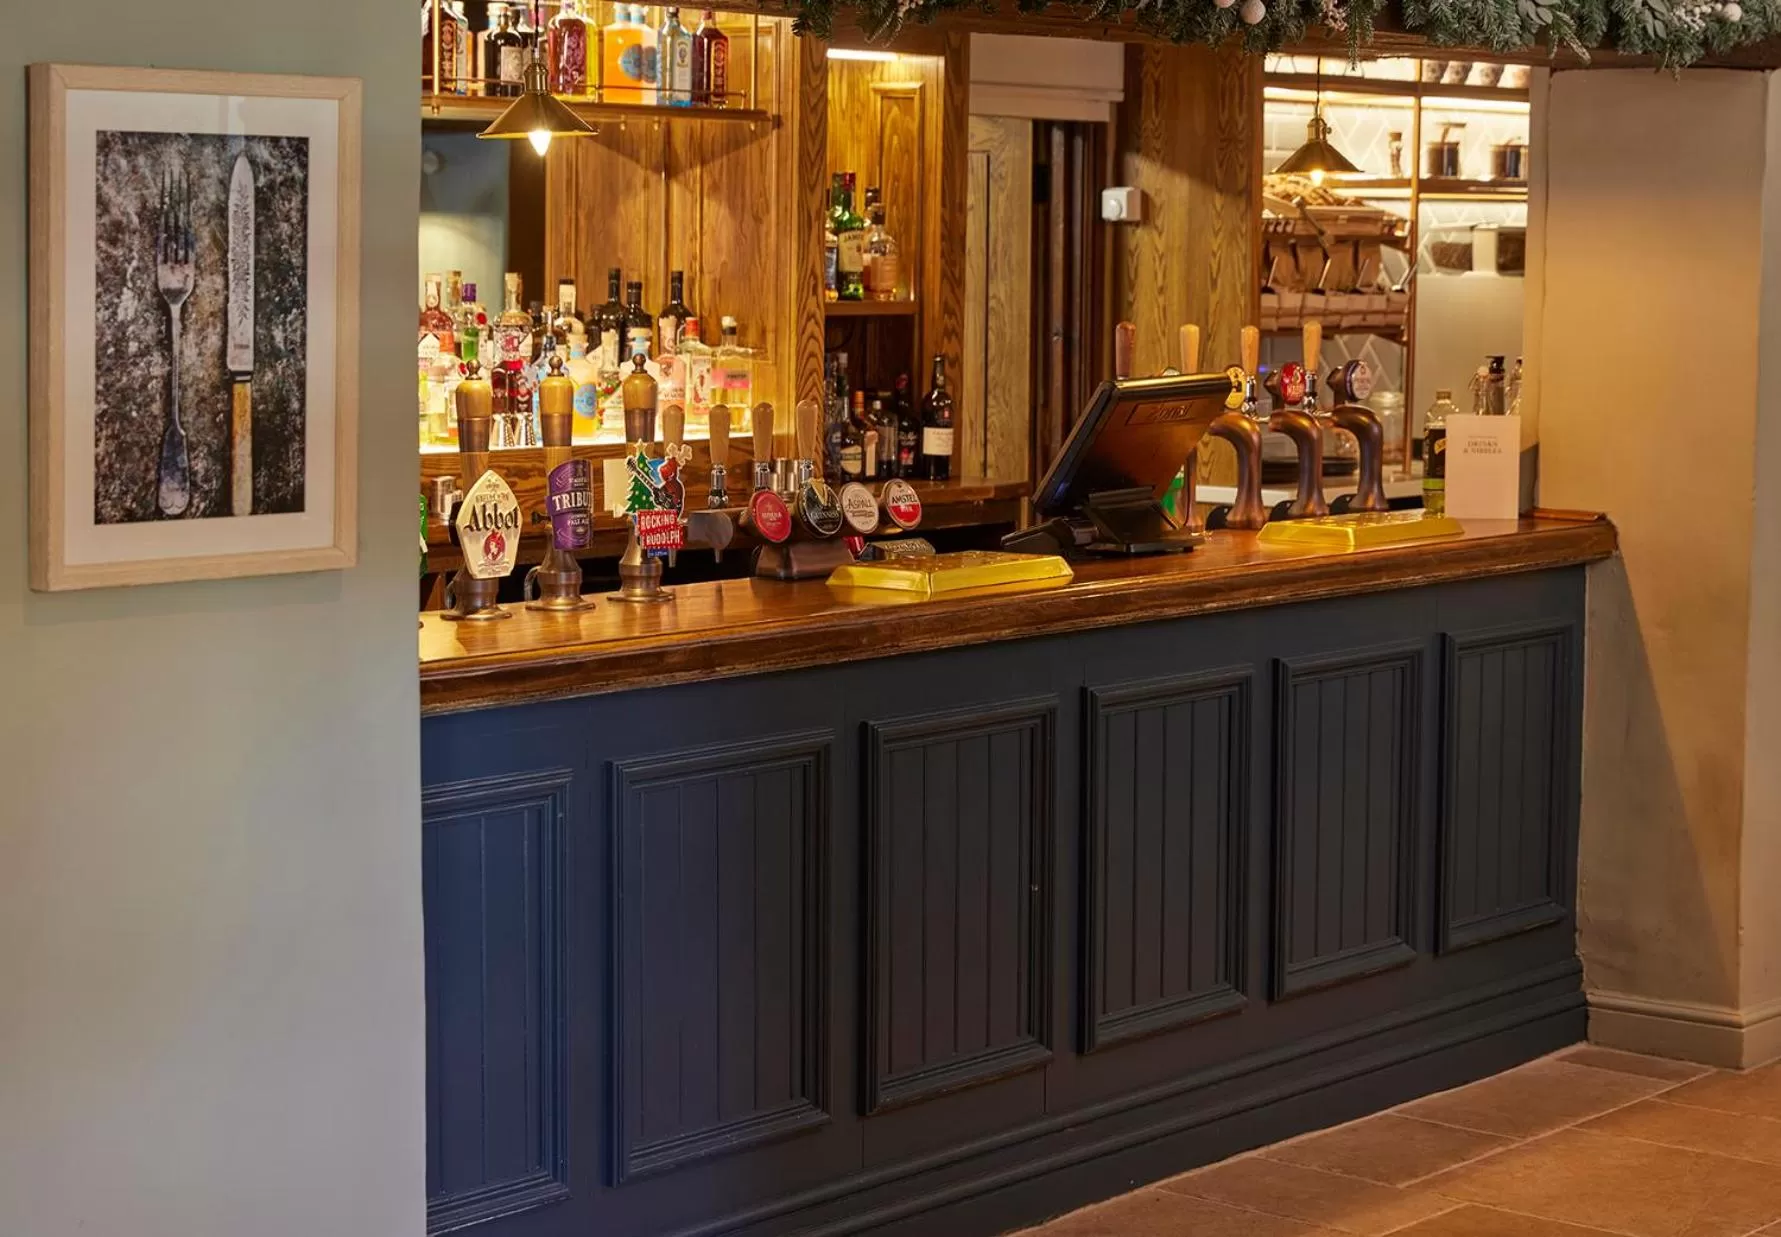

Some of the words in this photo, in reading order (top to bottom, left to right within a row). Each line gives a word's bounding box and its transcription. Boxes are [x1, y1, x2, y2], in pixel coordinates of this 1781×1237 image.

[463, 503, 519, 532] Abbot
[640, 514, 675, 530] ROCKING
[646, 529, 680, 546] RUDOLPH
